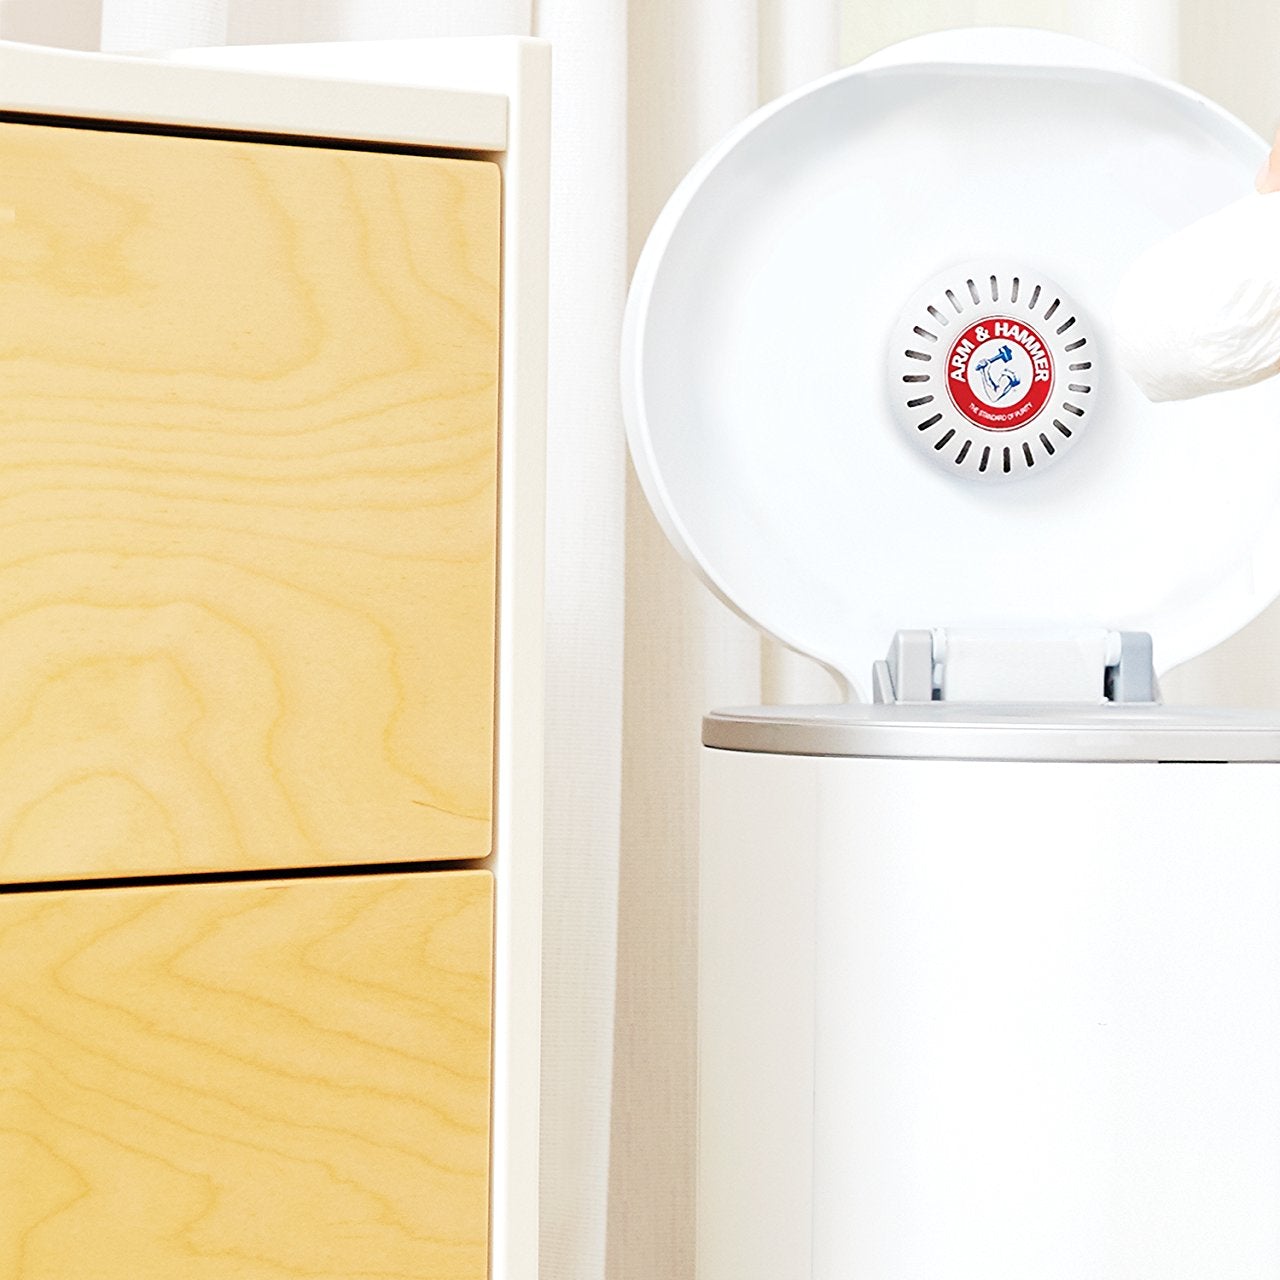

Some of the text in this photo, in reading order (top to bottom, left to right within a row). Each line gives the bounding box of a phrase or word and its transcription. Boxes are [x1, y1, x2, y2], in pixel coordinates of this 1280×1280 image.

[951, 322, 1049, 382] ARM & HAMMER
[968, 402, 979, 414] THE
[1007, 412, 1014, 421] OF
